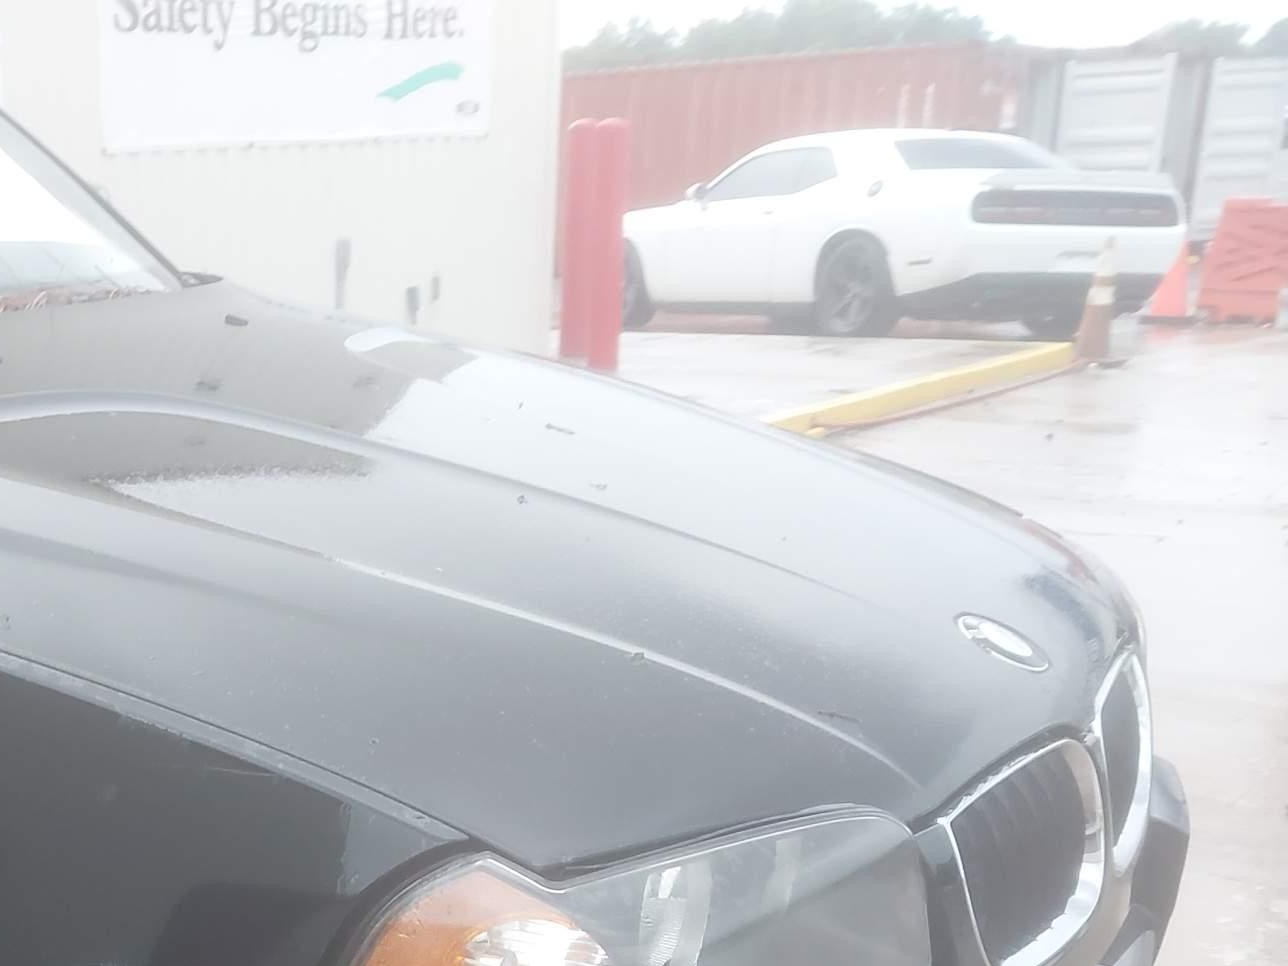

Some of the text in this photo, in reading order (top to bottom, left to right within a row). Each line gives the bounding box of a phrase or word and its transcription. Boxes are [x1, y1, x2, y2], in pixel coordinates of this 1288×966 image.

[112, 0, 466, 54] Safety Begins Here.
